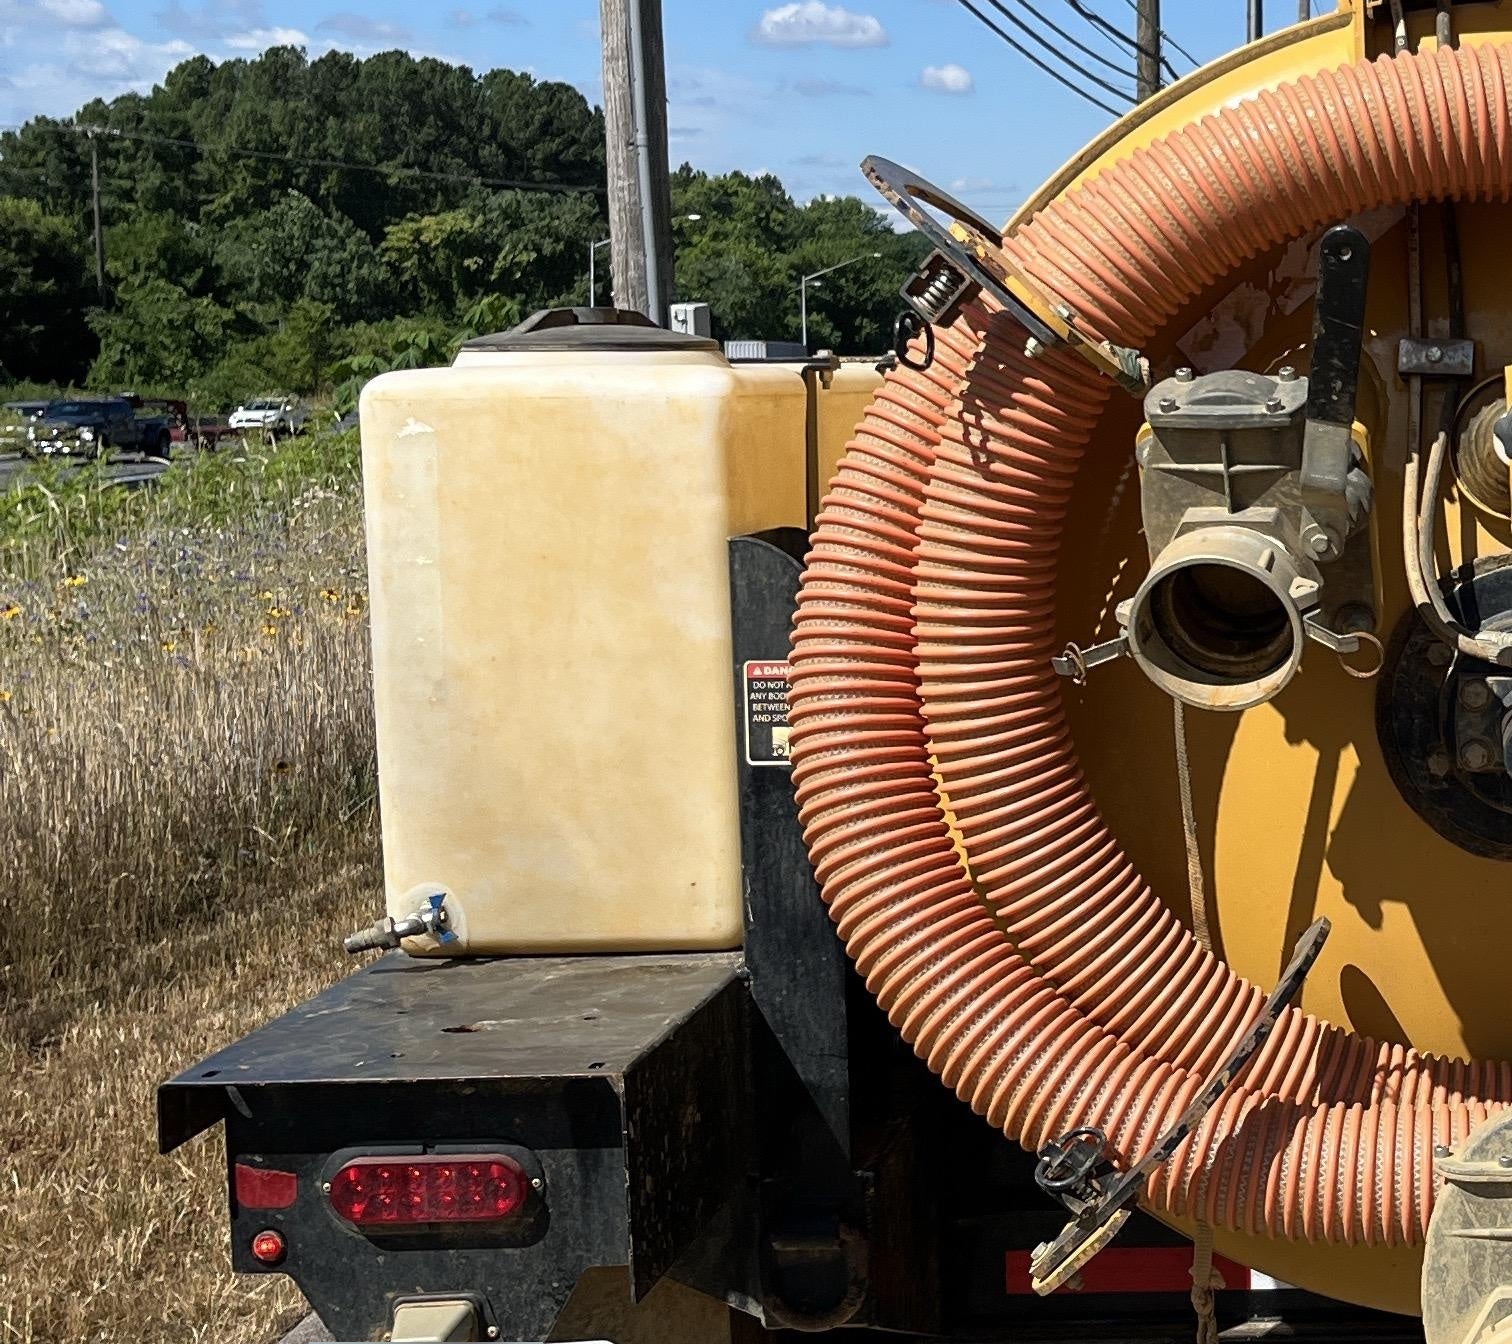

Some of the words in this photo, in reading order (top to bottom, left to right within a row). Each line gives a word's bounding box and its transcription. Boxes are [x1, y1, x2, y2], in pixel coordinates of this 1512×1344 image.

[752, 681, 766, 689] DO
[767, 680, 785, 689] NOT
[750, 692, 767, 700] ANY
[752, 703, 791, 711] BETWEEN
[752, 714, 771, 722] AND
